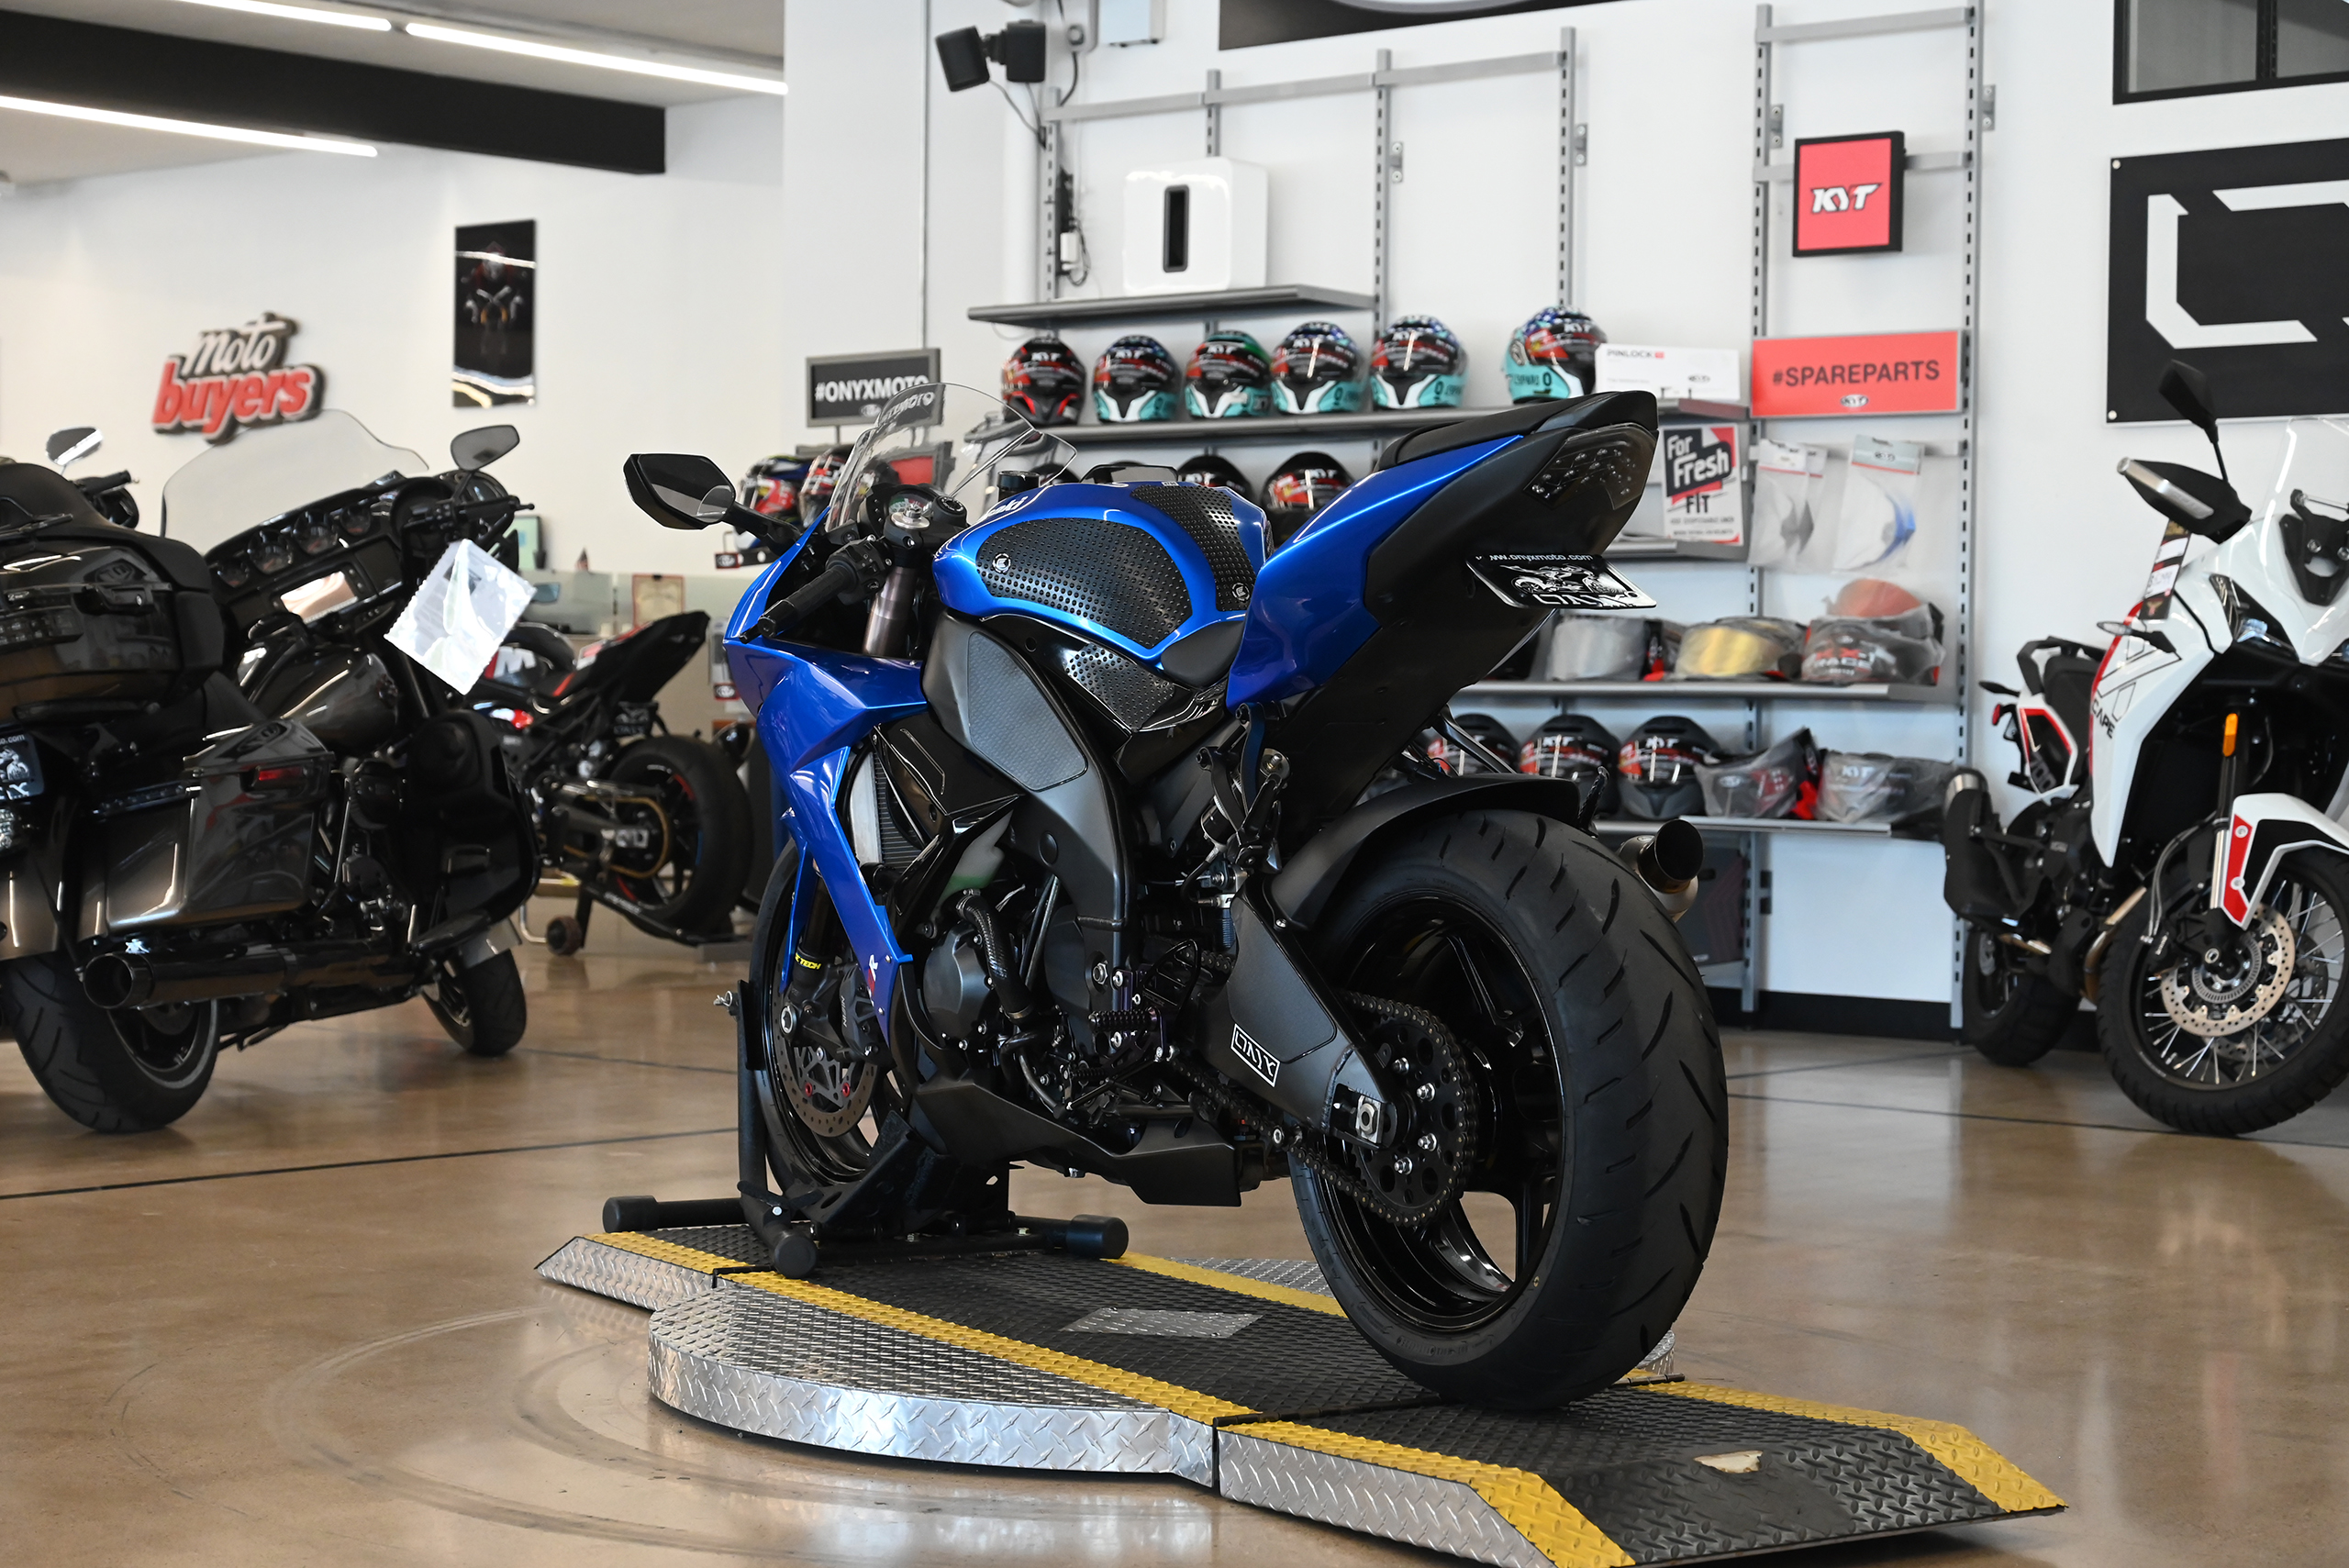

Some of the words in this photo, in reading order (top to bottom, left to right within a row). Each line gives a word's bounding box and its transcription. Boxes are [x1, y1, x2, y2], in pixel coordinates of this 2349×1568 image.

[1810, 183, 1882, 214] KYT
[1772, 360, 1941, 387] #SPAREPARTS
[152, 357, 314, 437] buyers
[1666, 434, 1694, 460] For
[1673, 448, 1730, 489] Fresh
[1686, 493, 1711, 514] FIT
[2092, 699, 2116, 740] CAPE
